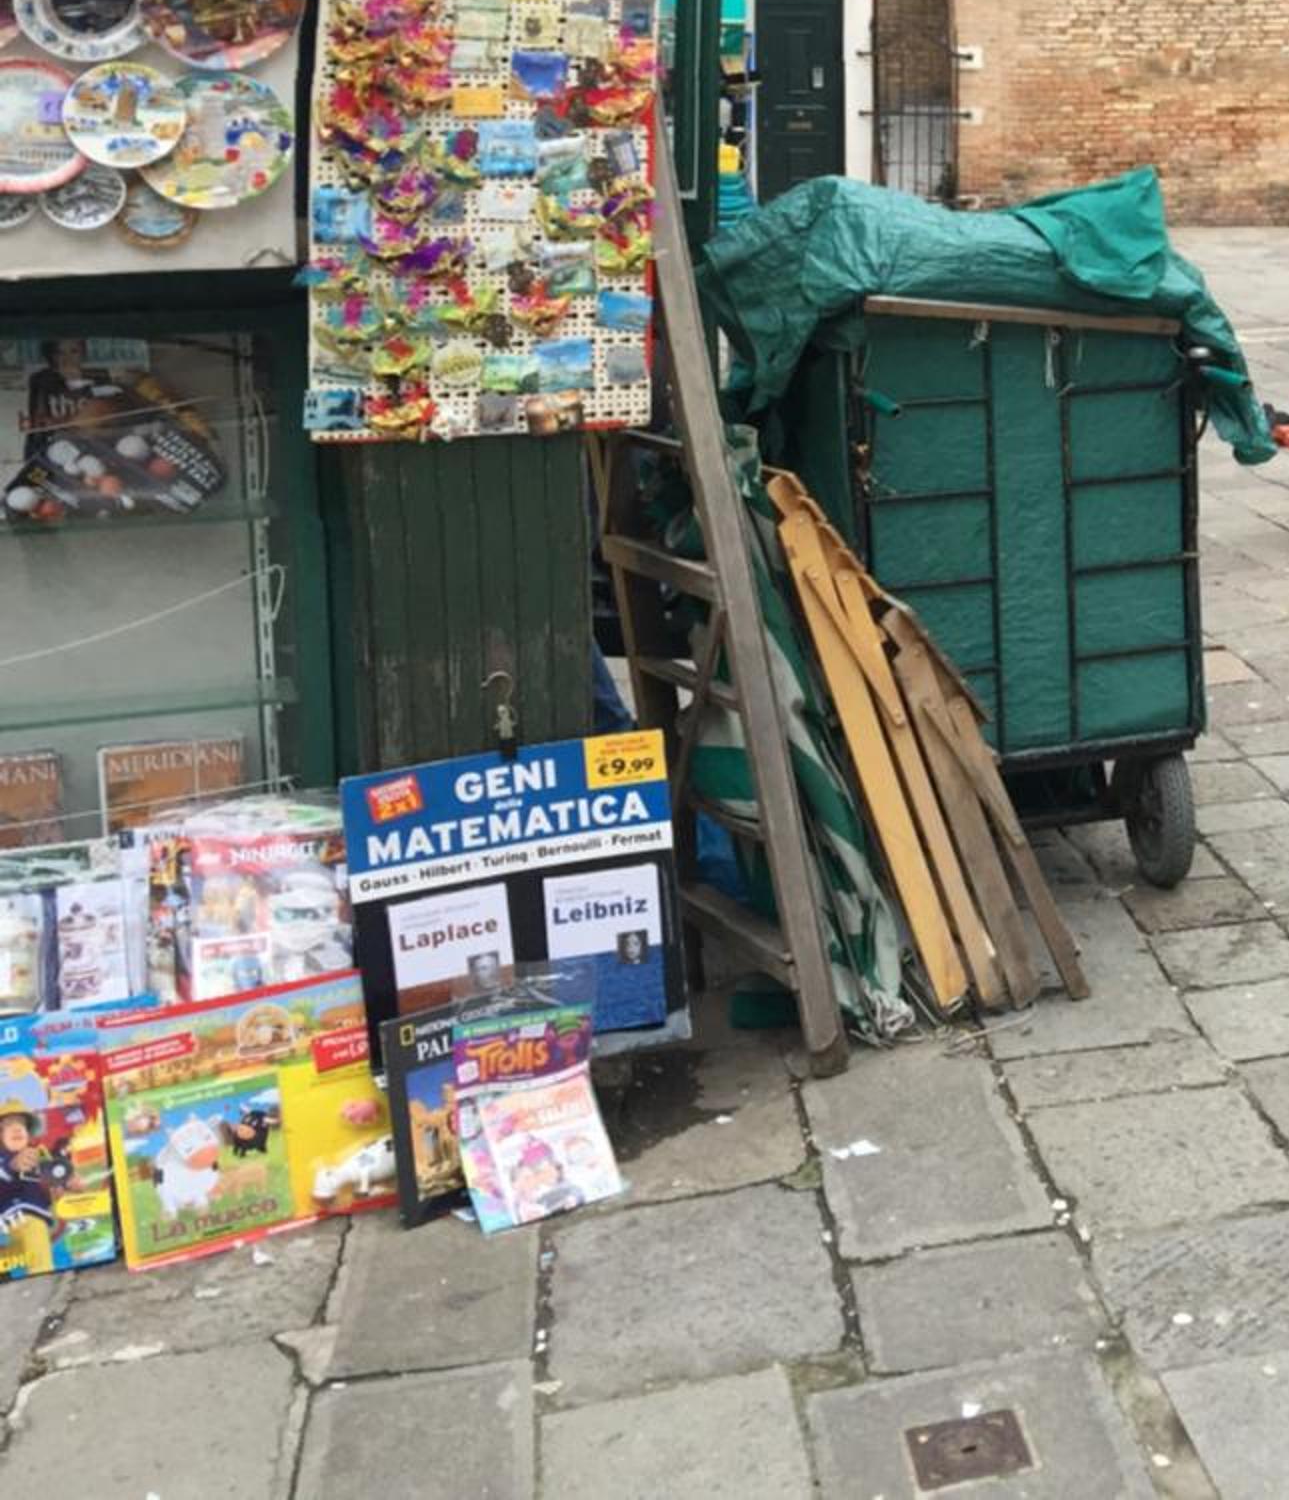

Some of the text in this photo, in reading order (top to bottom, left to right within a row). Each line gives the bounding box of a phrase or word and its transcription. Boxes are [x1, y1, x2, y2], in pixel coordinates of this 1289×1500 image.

[454, 758, 557, 803] GENI
[366, 790, 650, 865] MATEMATICA
[360, 829, 662, 893] Gauss Hilbert Turing Bernoulli Fermat
[553, 896, 648, 925] Leibniz
[399, 916, 499, 952] Laplace
